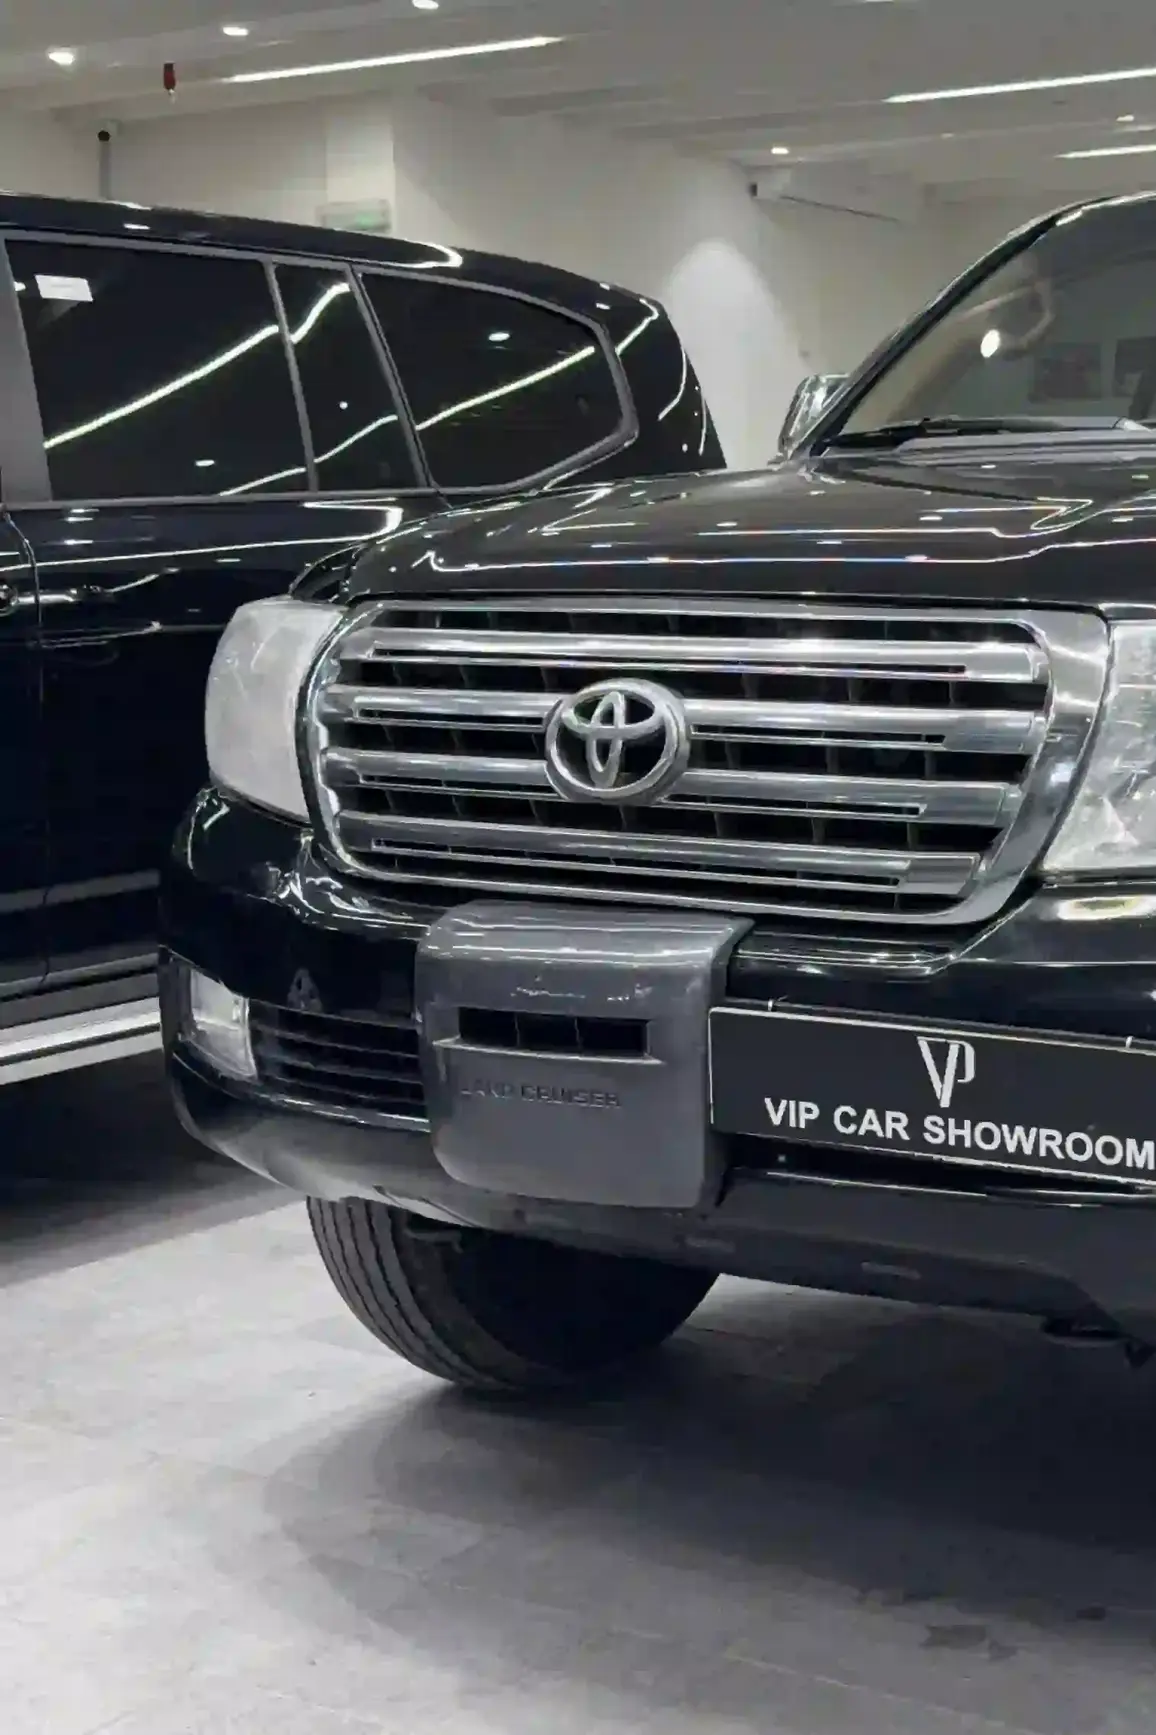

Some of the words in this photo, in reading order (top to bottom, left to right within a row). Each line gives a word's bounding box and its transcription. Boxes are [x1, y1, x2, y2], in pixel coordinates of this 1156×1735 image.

[764, 1097, 820, 1129] VIP
[833, 1105, 911, 1141] CAR
[923, 1115, 1155, 1171] SHOWROOM
